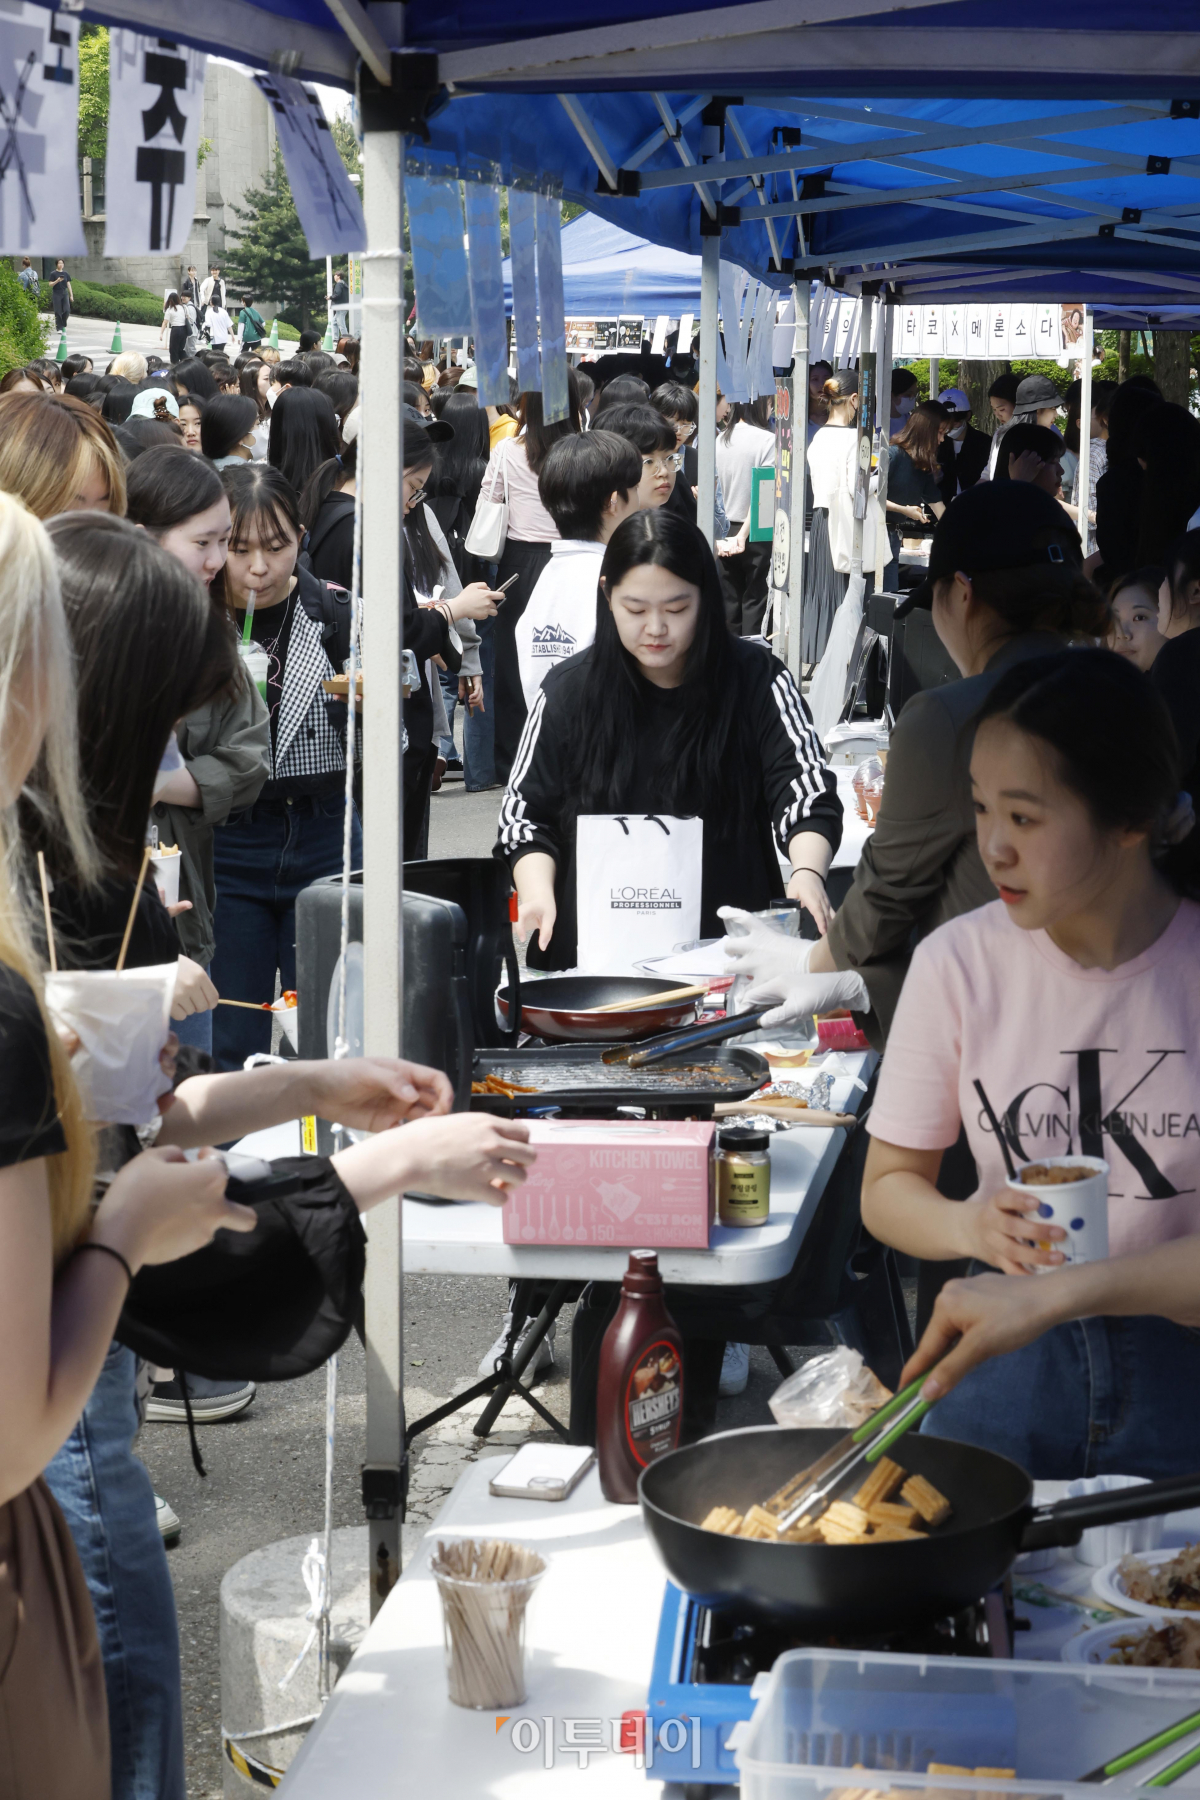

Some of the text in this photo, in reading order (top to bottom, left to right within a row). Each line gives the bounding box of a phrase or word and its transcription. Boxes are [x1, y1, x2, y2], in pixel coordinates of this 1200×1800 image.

[977, 1108, 1071, 1139] CALVIN
[589, 1149, 650, 1169] KITCHEN
[652, 1150, 703, 1170] TOWEL
[671, 1213, 703, 1227] BON
[591, 1224, 615, 1242] 150
[653, 1226, 702, 1243] HOMEMADE
